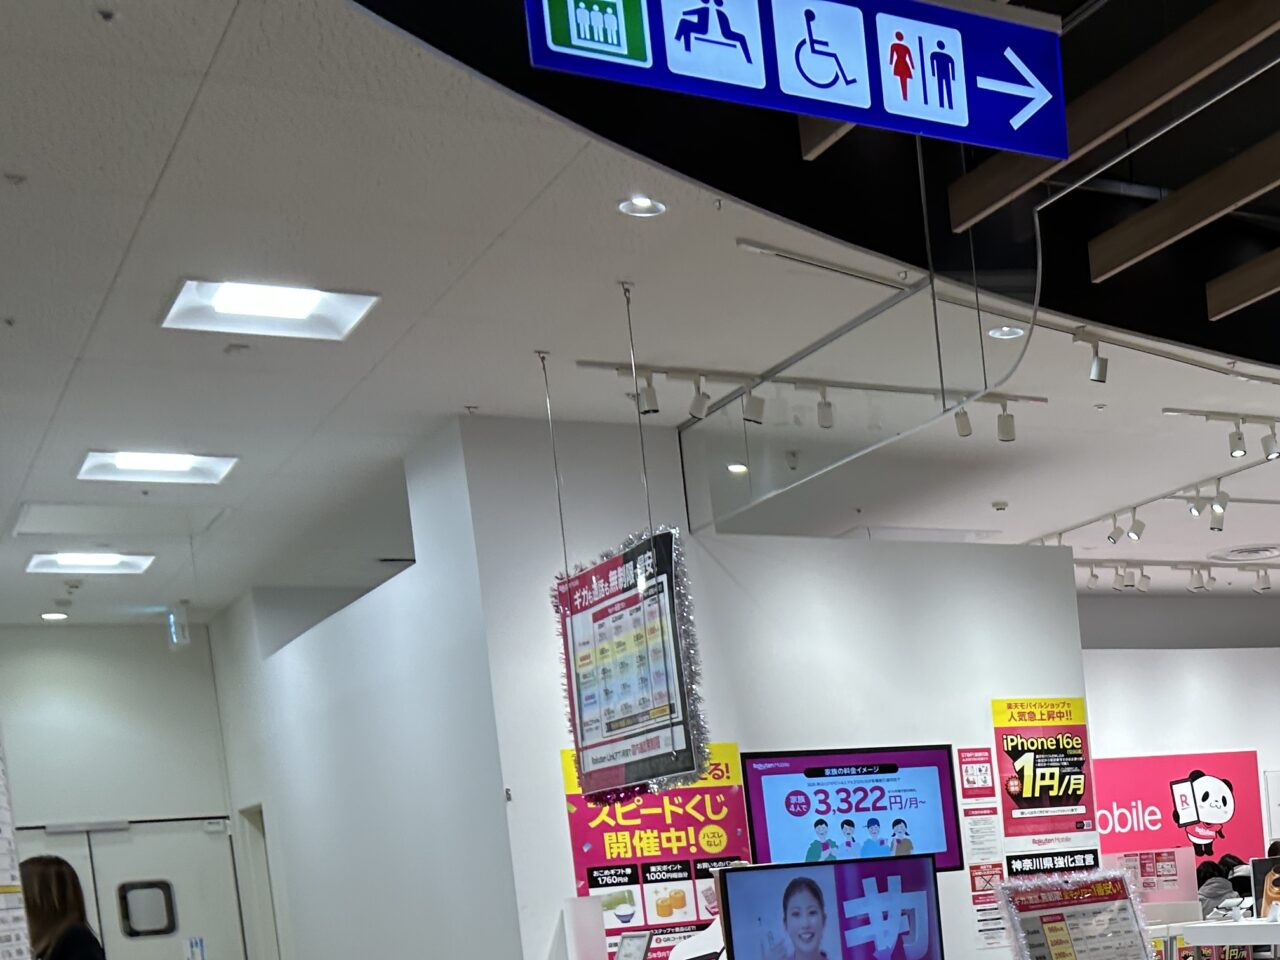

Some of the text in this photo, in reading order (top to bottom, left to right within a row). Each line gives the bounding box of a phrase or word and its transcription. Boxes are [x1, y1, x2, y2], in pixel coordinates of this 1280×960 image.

[1006, 701, 1072, 710] 楽天モバイルショップで
[1002, 733, 1082, 751] iPhone 16e
[824, 765, 880, 776] 家族の料金イメージ
[1013, 752, 1085, 798] 1円/月
[1179, 794, 1190, 808] R
[587, 793, 729, 828] スピードくじ
[603, 826, 698, 860] 開催中!
[650, 864, 682, 872] 楽天ポイント
[1011, 854, 1095, 873] 神奈川県強化宣言
